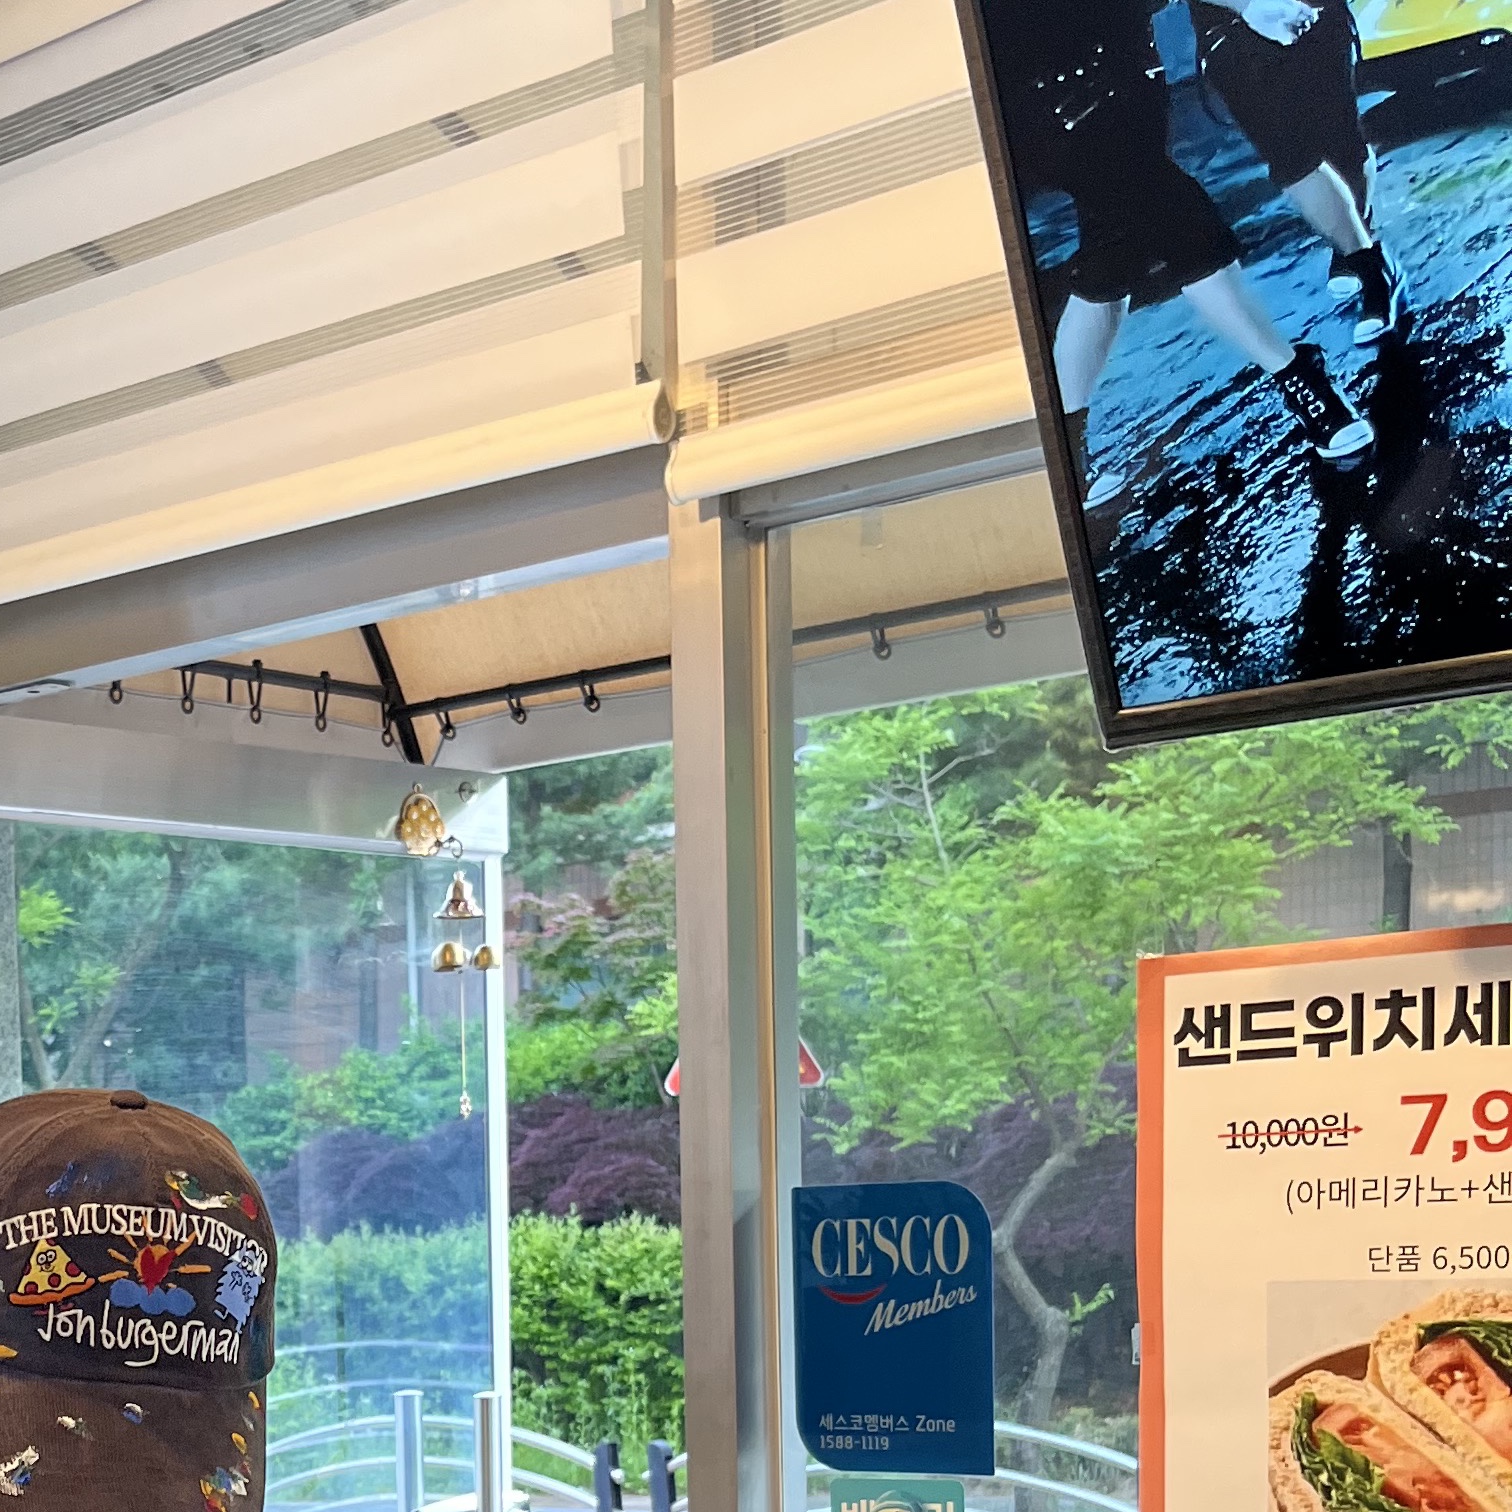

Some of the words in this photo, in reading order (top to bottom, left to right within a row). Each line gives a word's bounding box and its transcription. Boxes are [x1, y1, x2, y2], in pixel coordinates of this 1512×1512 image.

[1173, 979, 1512, 1068] 샌드위치세
[1225, 1112, 1350, 1155] 10,000원
[1400, 1089, 1512, 1163] 7,9
[1285, 1171, 1512, 1215] (아메리카노+샌
[59, 1203, 189, 1243] MUSEUM
[811, 1213, 970, 1279] CESCO
[1367, 1245, 1422, 1273] 단품
[1432, 1244, 1510, 1275] 6,500
[863, 1278, 978, 1337] Members
[818, 1412, 910, 1433] 세스코멤버스
[915, 1414, 956, 1433] Zone
[819, 1434, 890, 1451] 1588-1119
